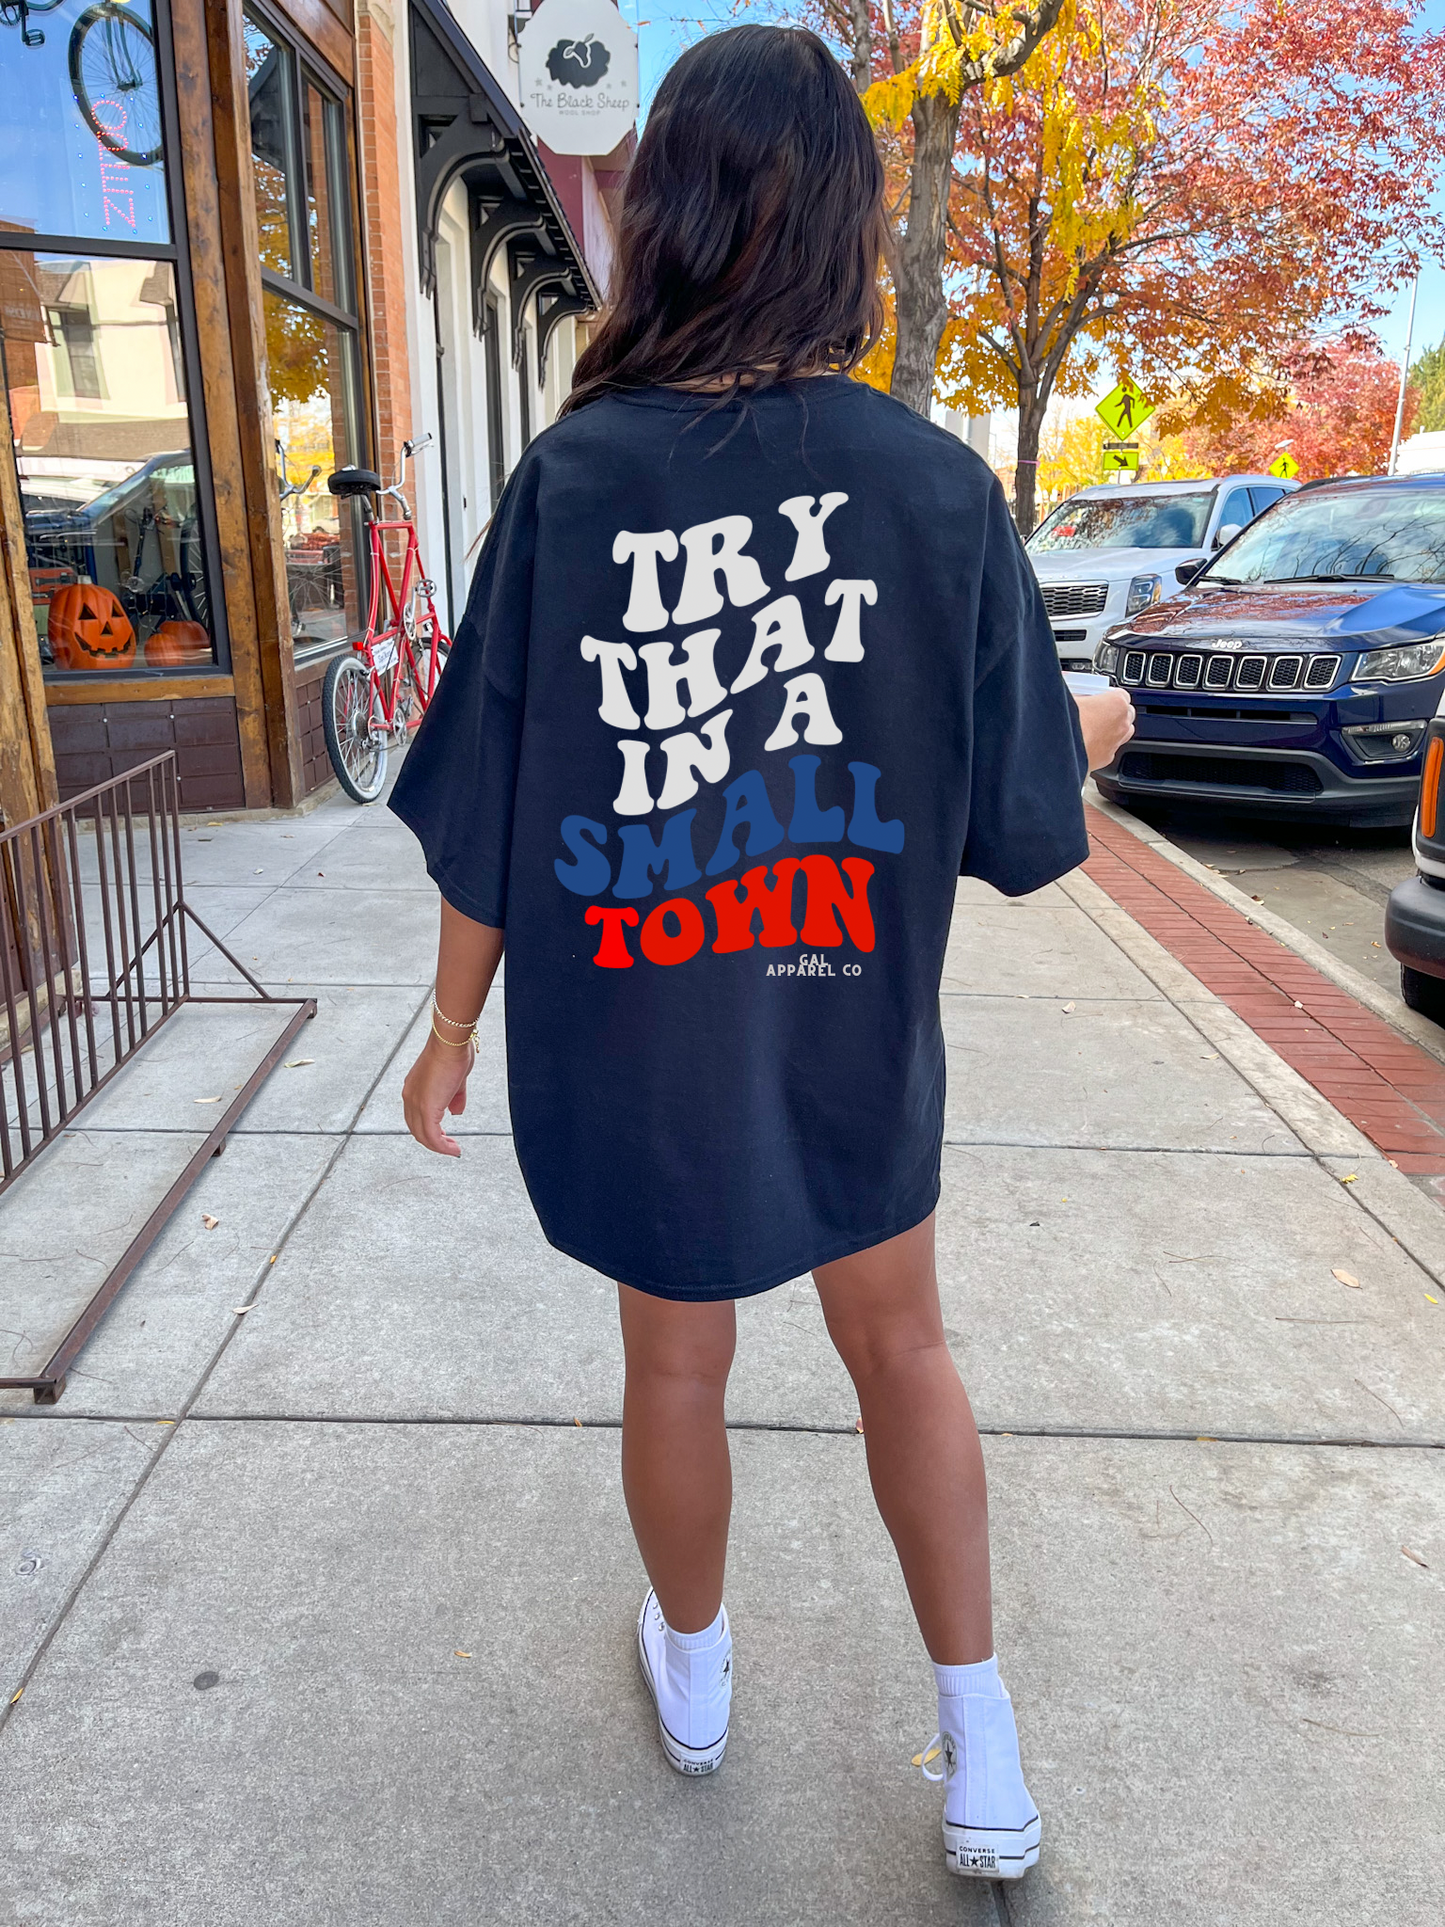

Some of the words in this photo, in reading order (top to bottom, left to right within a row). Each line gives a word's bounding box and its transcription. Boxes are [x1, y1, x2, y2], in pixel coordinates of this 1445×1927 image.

[530, 93, 552, 108] The
[557, 92, 594, 108] Black
[597, 92, 630, 111] Sheep
[91, 99, 136, 227] OPEN
[613, 492, 849, 632] TRY
[580, 579, 878, 730] THAT
[1211, 639, 1243, 650] Jeep
[613, 709, 733, 815] IN
[764, 673, 843, 751] A
[554, 754, 905, 899] SMALL
[585, 855, 875, 969] TOWN
[799, 953, 828, 966] GAL
[766, 964, 836, 977] APPAREL
[842, 964, 862, 977] CO
[959, 1845, 995, 1854] CONVERSE
